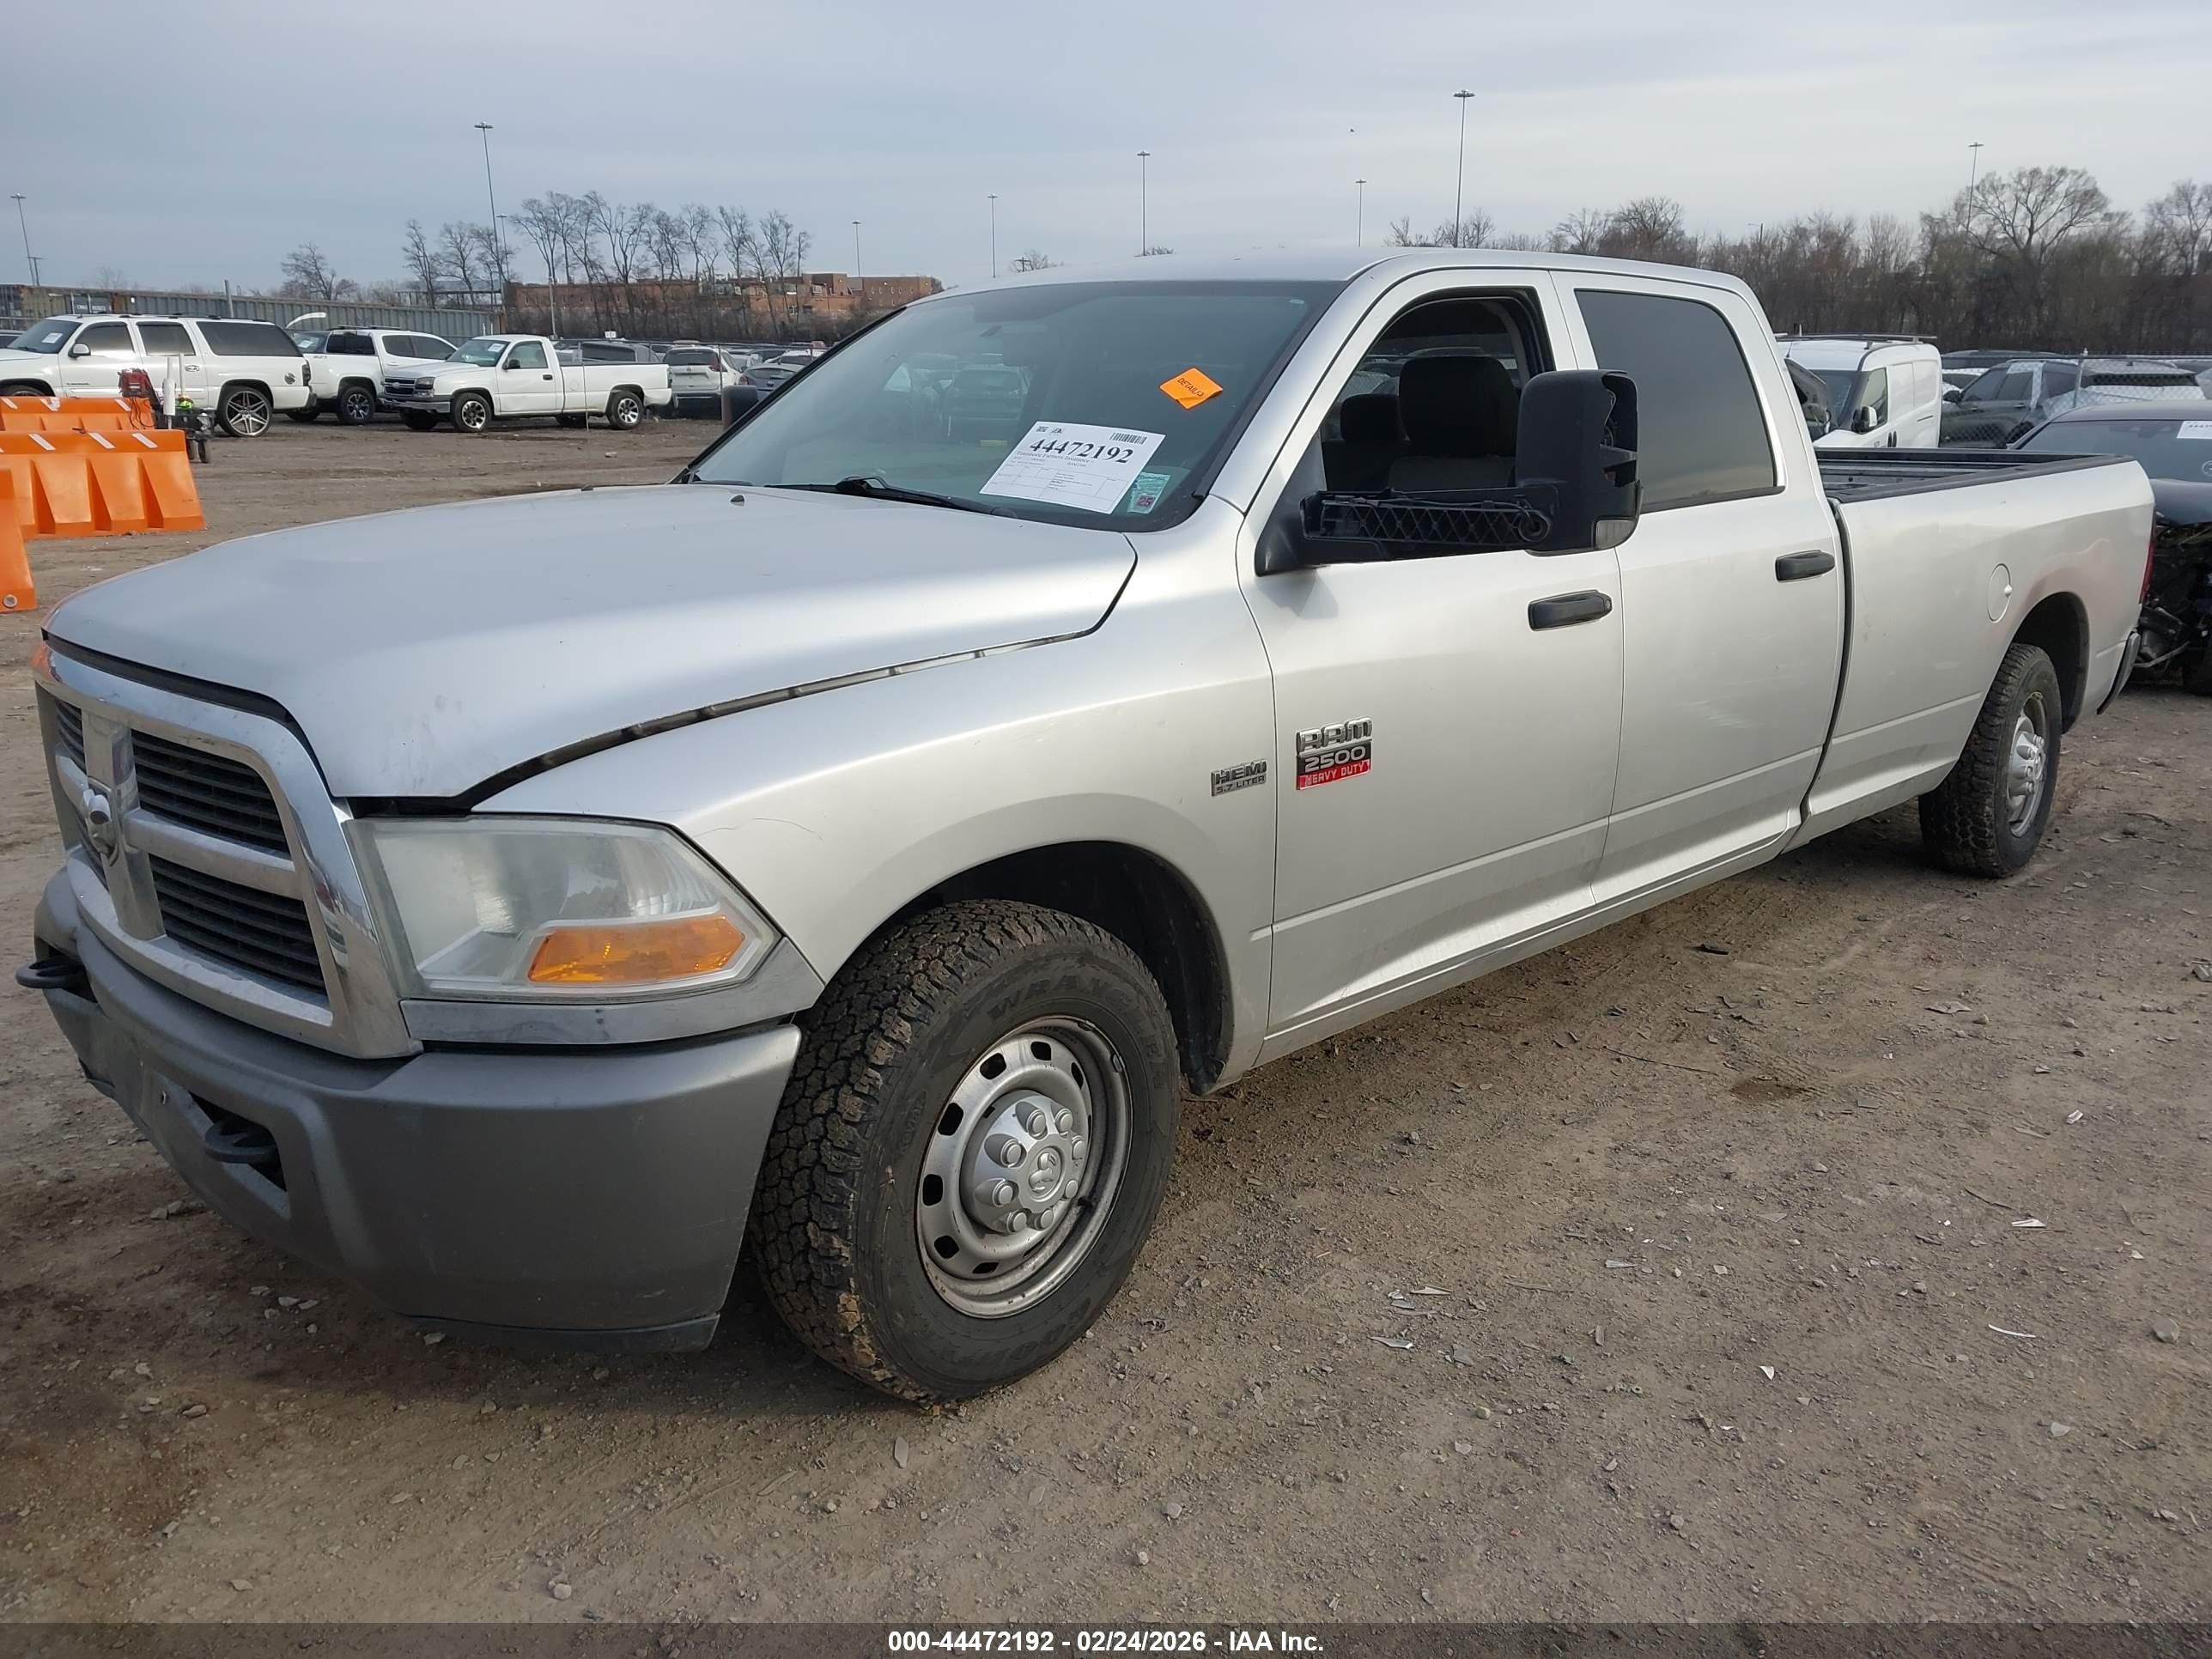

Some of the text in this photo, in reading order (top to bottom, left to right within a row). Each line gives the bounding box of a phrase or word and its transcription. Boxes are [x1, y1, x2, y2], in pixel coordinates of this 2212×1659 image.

[1030, 439, 1133, 464] 44472192
[1297, 717, 1373, 752] RAM
[1304, 745, 1366, 772] 2500
[1216, 759, 1267, 784] HEMI
[1305, 761, 1366, 786] HEAVY DUTY
[1216, 775, 1266, 794] 5.7 LITER
